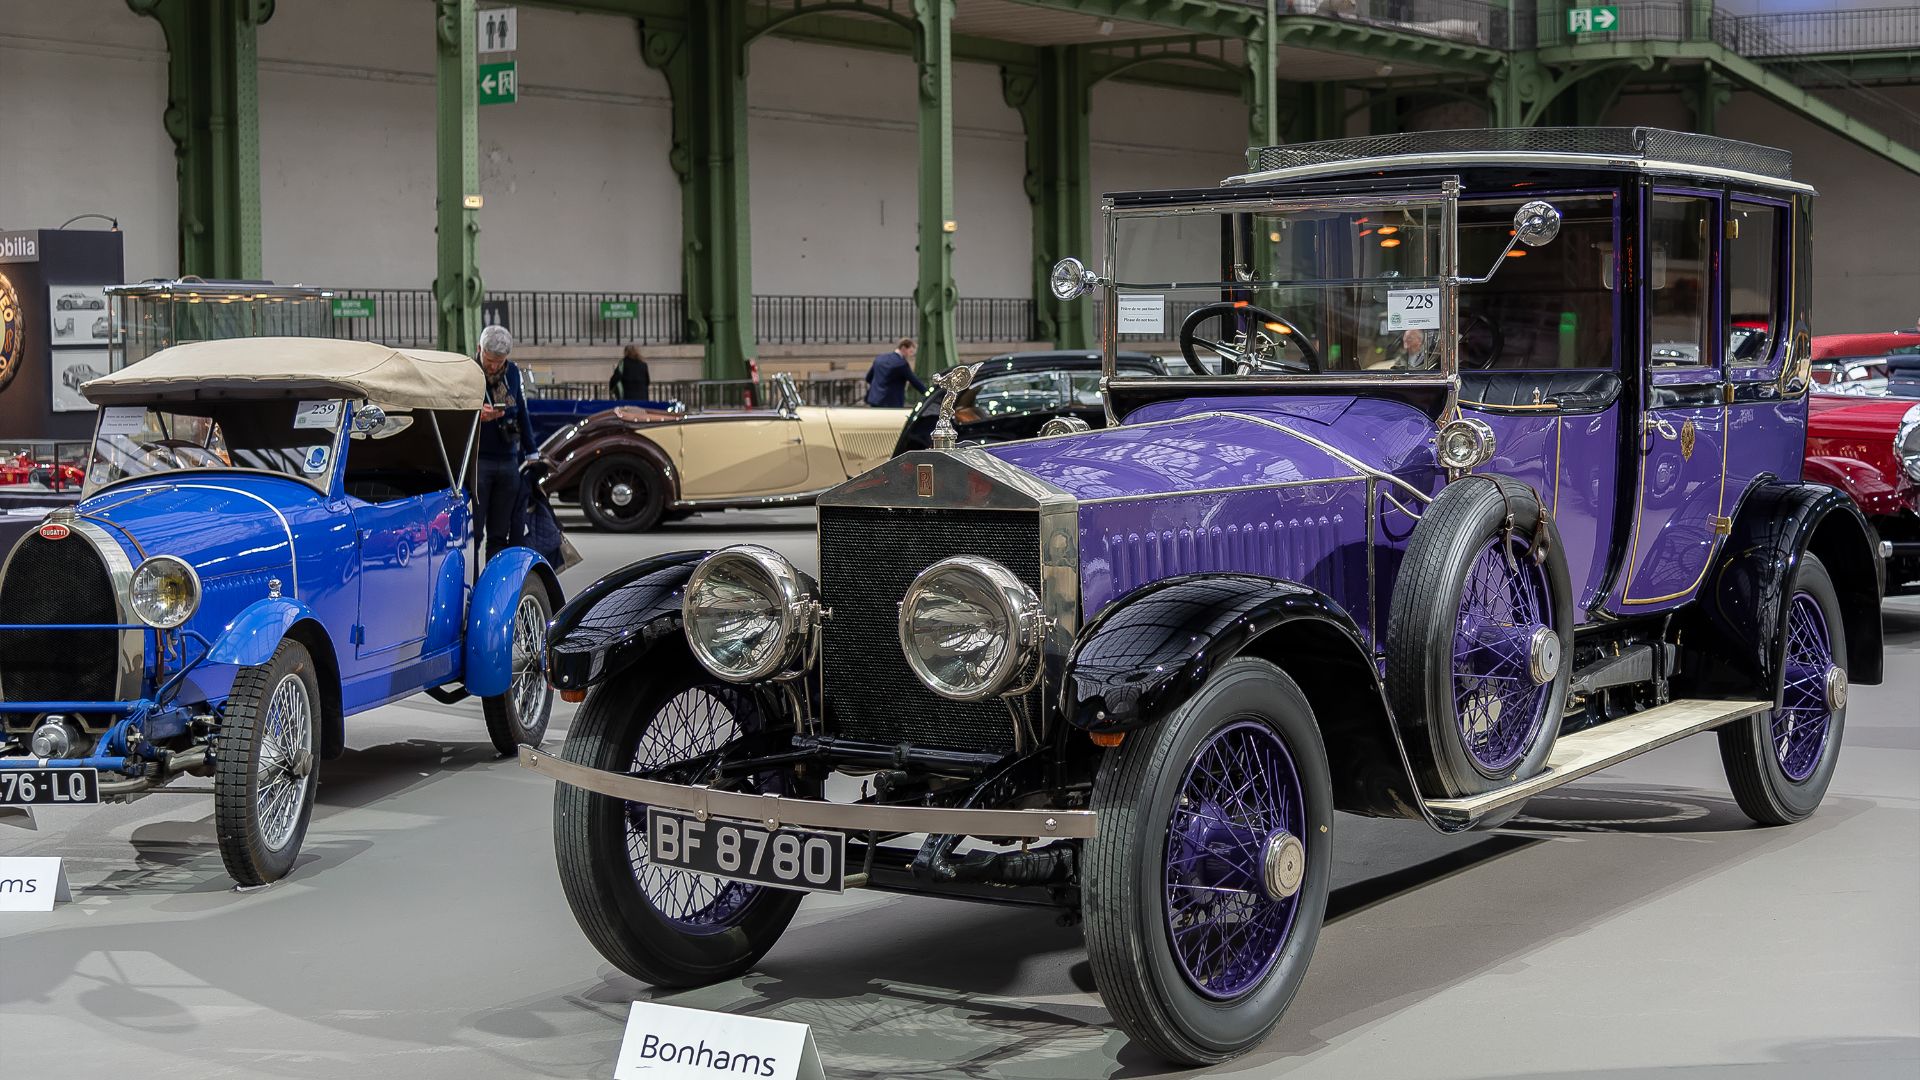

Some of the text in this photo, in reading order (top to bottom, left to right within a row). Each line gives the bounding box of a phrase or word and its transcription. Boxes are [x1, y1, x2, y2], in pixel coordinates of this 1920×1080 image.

[1406, 294, 1433, 309] 228
[311, 404, 336, 415] 239
[656, 815, 832, 884] BF 8780
[640, 1034, 776, 1077] Bonhams
